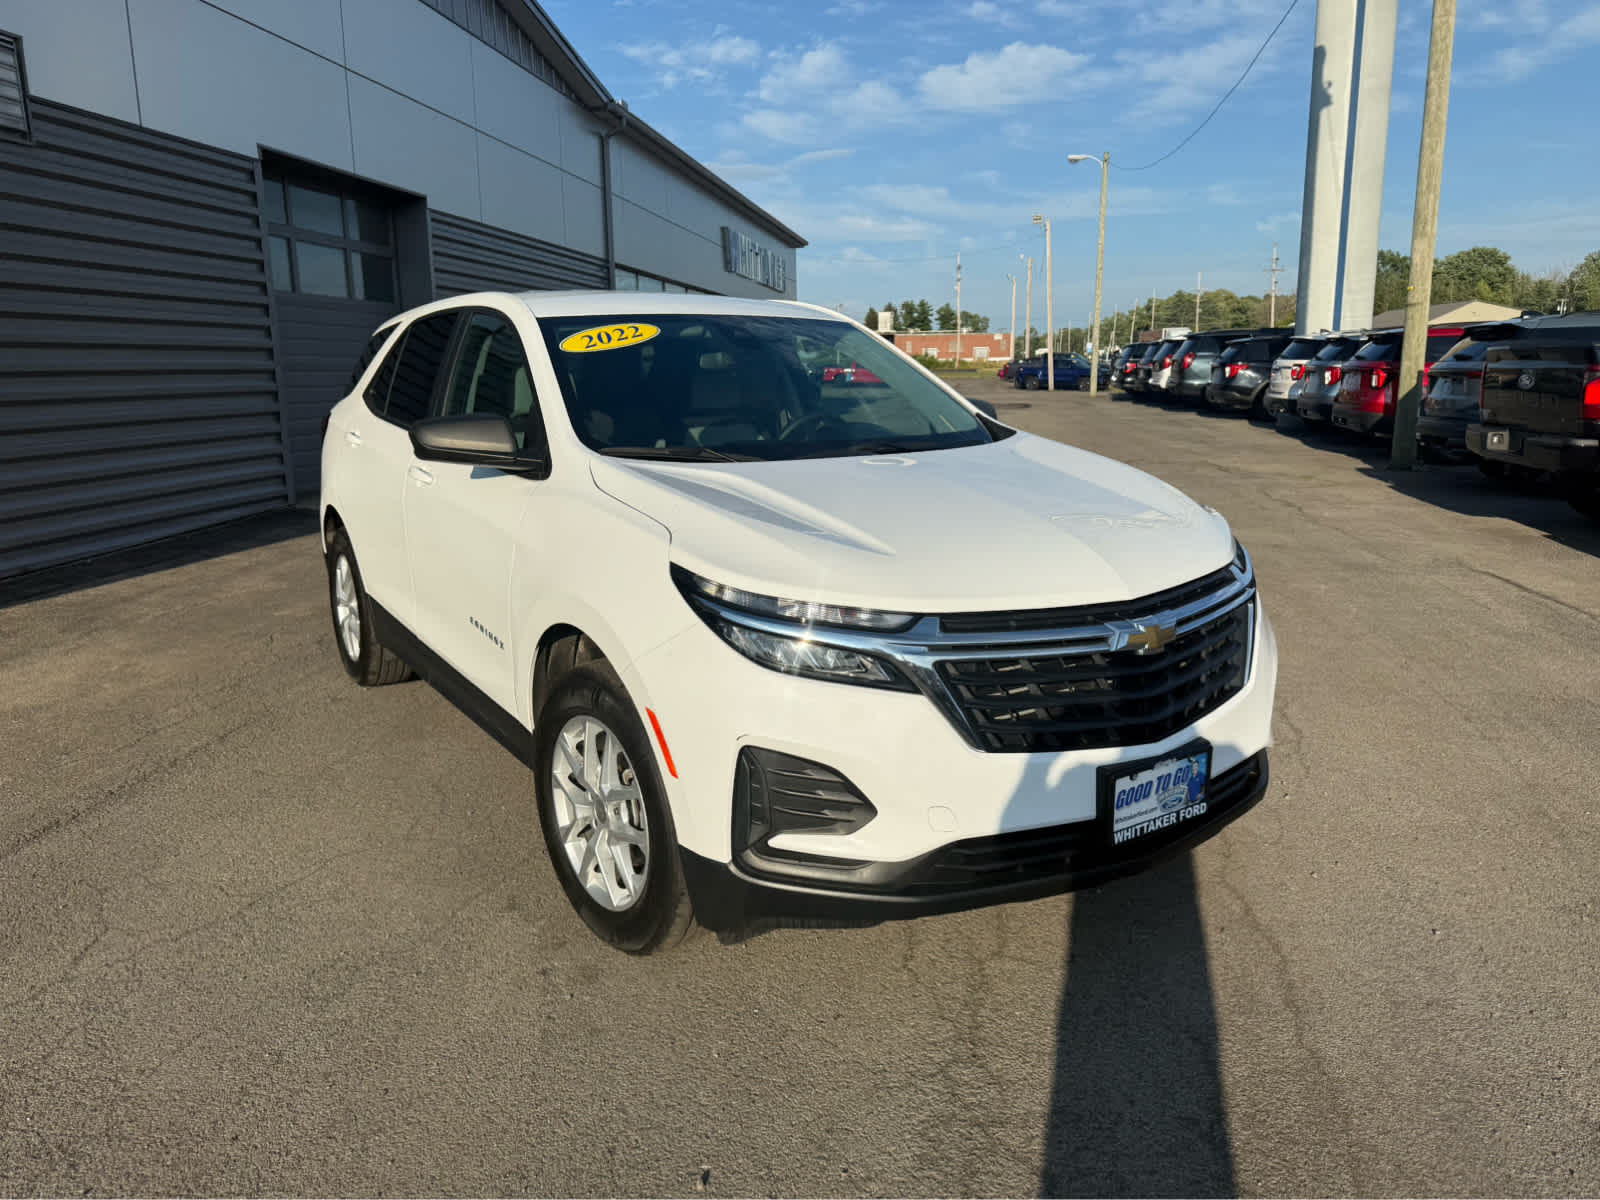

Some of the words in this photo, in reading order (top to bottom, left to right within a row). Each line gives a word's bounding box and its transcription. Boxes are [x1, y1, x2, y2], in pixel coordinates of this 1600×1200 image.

[581, 325, 643, 349] 2022
[1115, 780, 1153, 811] GOOD
[1155, 773, 1171, 794] TO
[1173, 765, 1191, 787] GO
[1114, 812, 1177, 845] WHITTAKER
[1179, 802, 1207, 822] FORD
